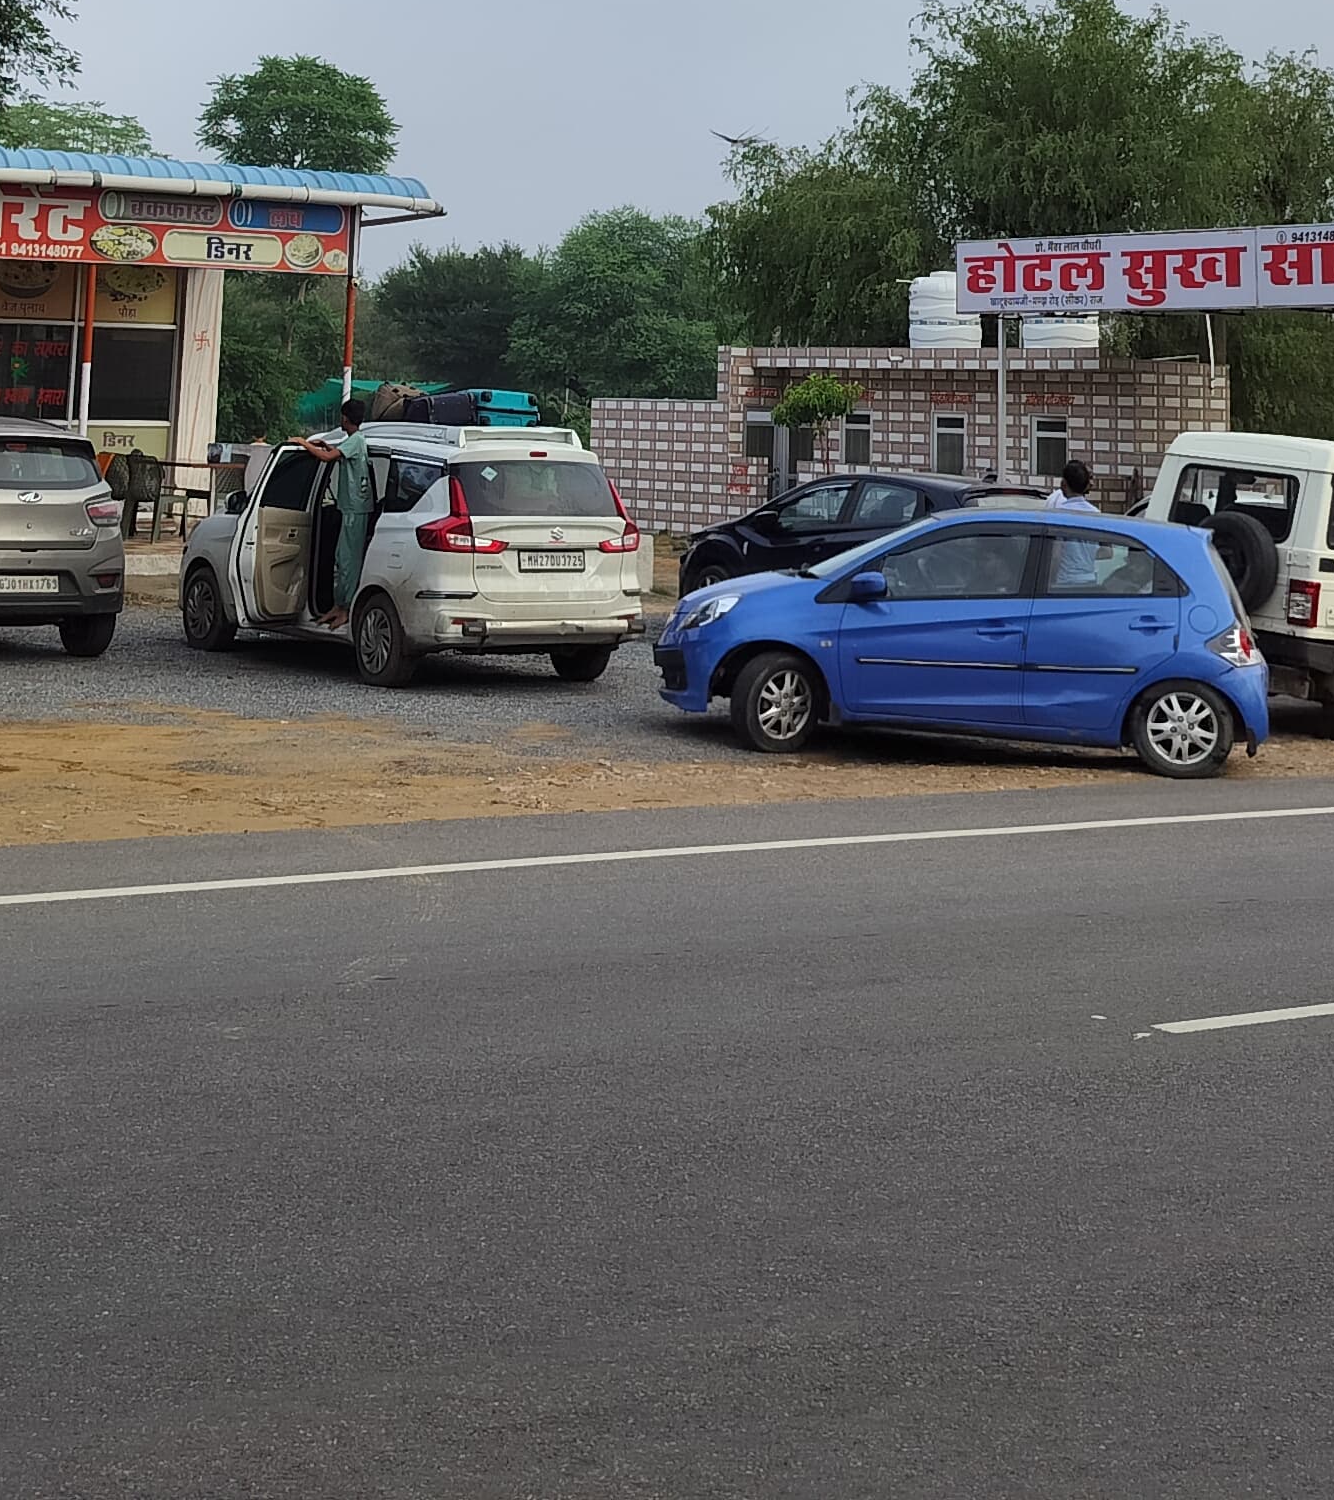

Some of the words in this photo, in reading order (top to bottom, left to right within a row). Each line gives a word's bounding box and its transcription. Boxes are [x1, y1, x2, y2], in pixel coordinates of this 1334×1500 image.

[10, 242, 84, 258] 9413148077
[206, 236, 255, 261] डिनर
[964, 243, 1110, 293] होटल
[1121, 246, 1247, 306] सुख
[103, 432, 135, 448] डिनर
